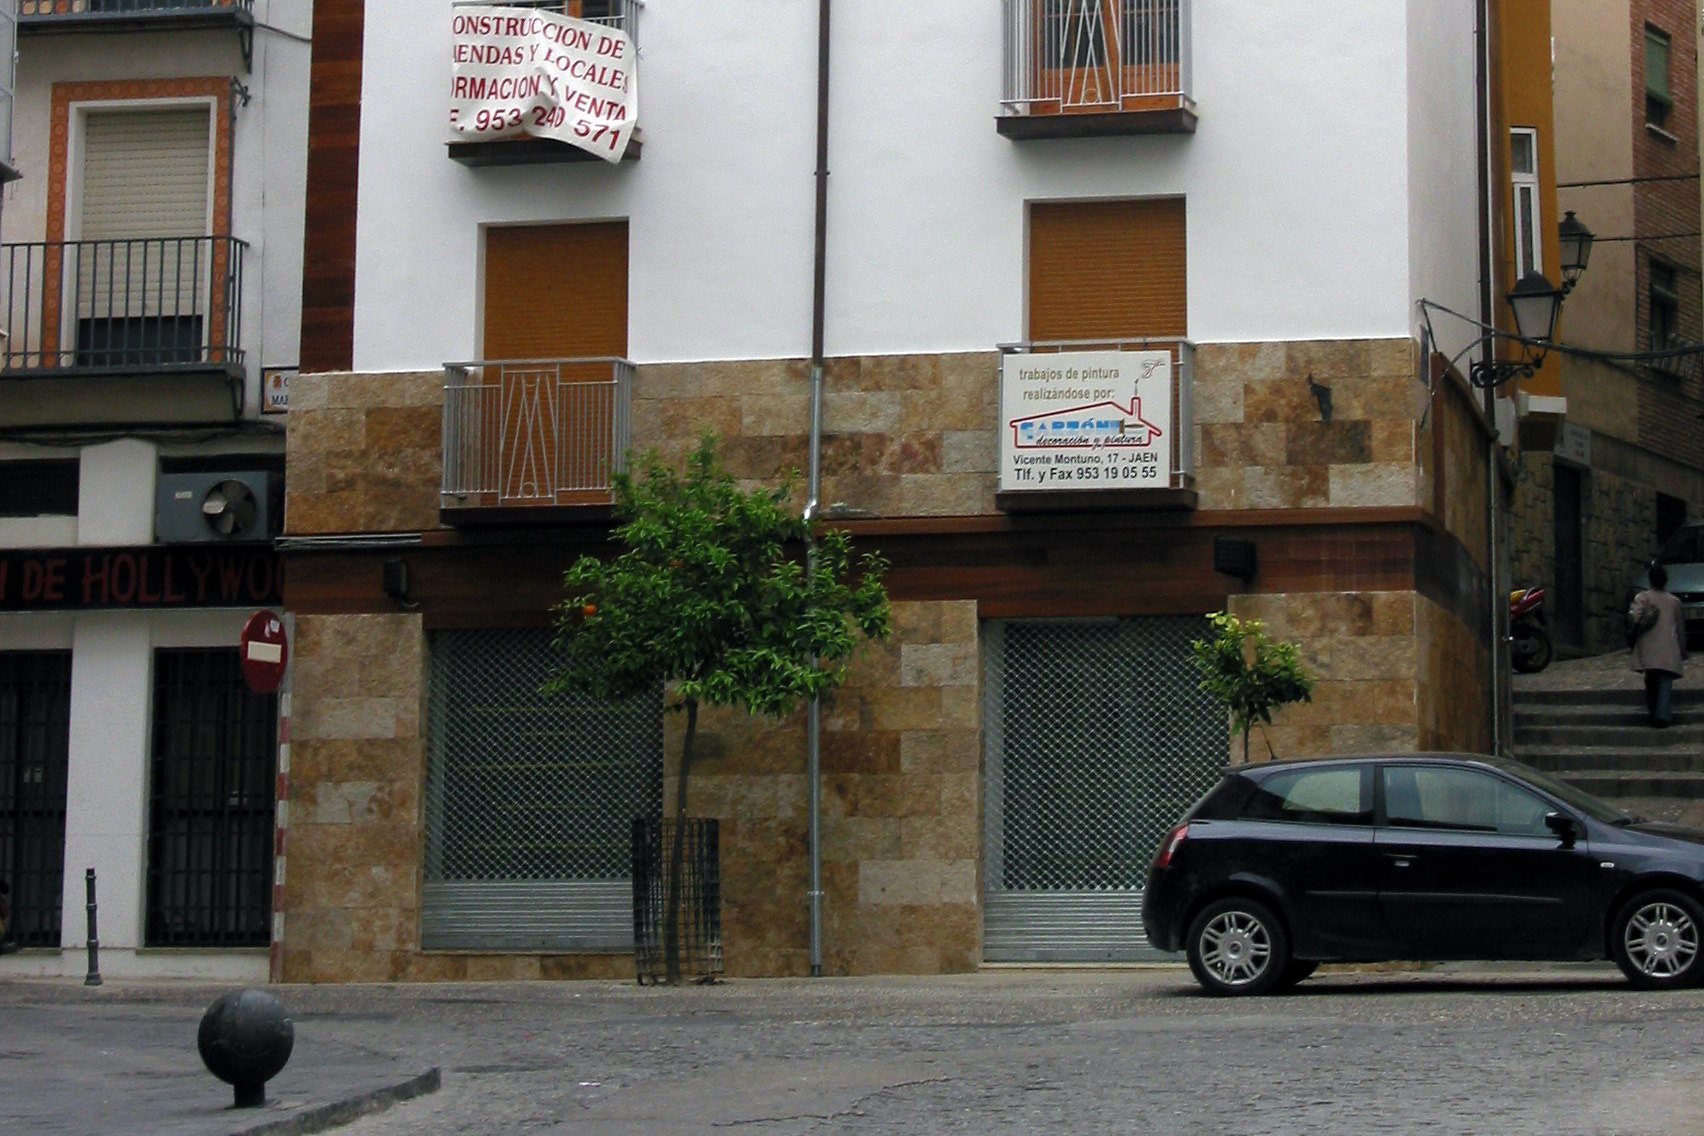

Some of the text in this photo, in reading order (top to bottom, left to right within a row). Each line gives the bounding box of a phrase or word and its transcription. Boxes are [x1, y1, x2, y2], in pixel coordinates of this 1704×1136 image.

[530, 43, 540, 62] Y
[597, 36, 626, 59] DE
[547, 74, 559, 97] Y
[565, 85, 626, 121] VENTA
[475, 108, 523, 132] 953
[532, 105, 566, 128] 240
[574, 119, 621, 151] 571
[1019, 366, 1120, 383] trabajos de pintura
[1023, 387, 1116, 401] realizándose por:
[1013, 454, 1052, 465] Vicente
[1108, 453, 1119, 463] 17
[1129, 452, 1158, 463] JAEN
[1014, 466, 1157, 483] Tlf. y Fax 953 19 05 55
[20, 557, 68, 604] DE
